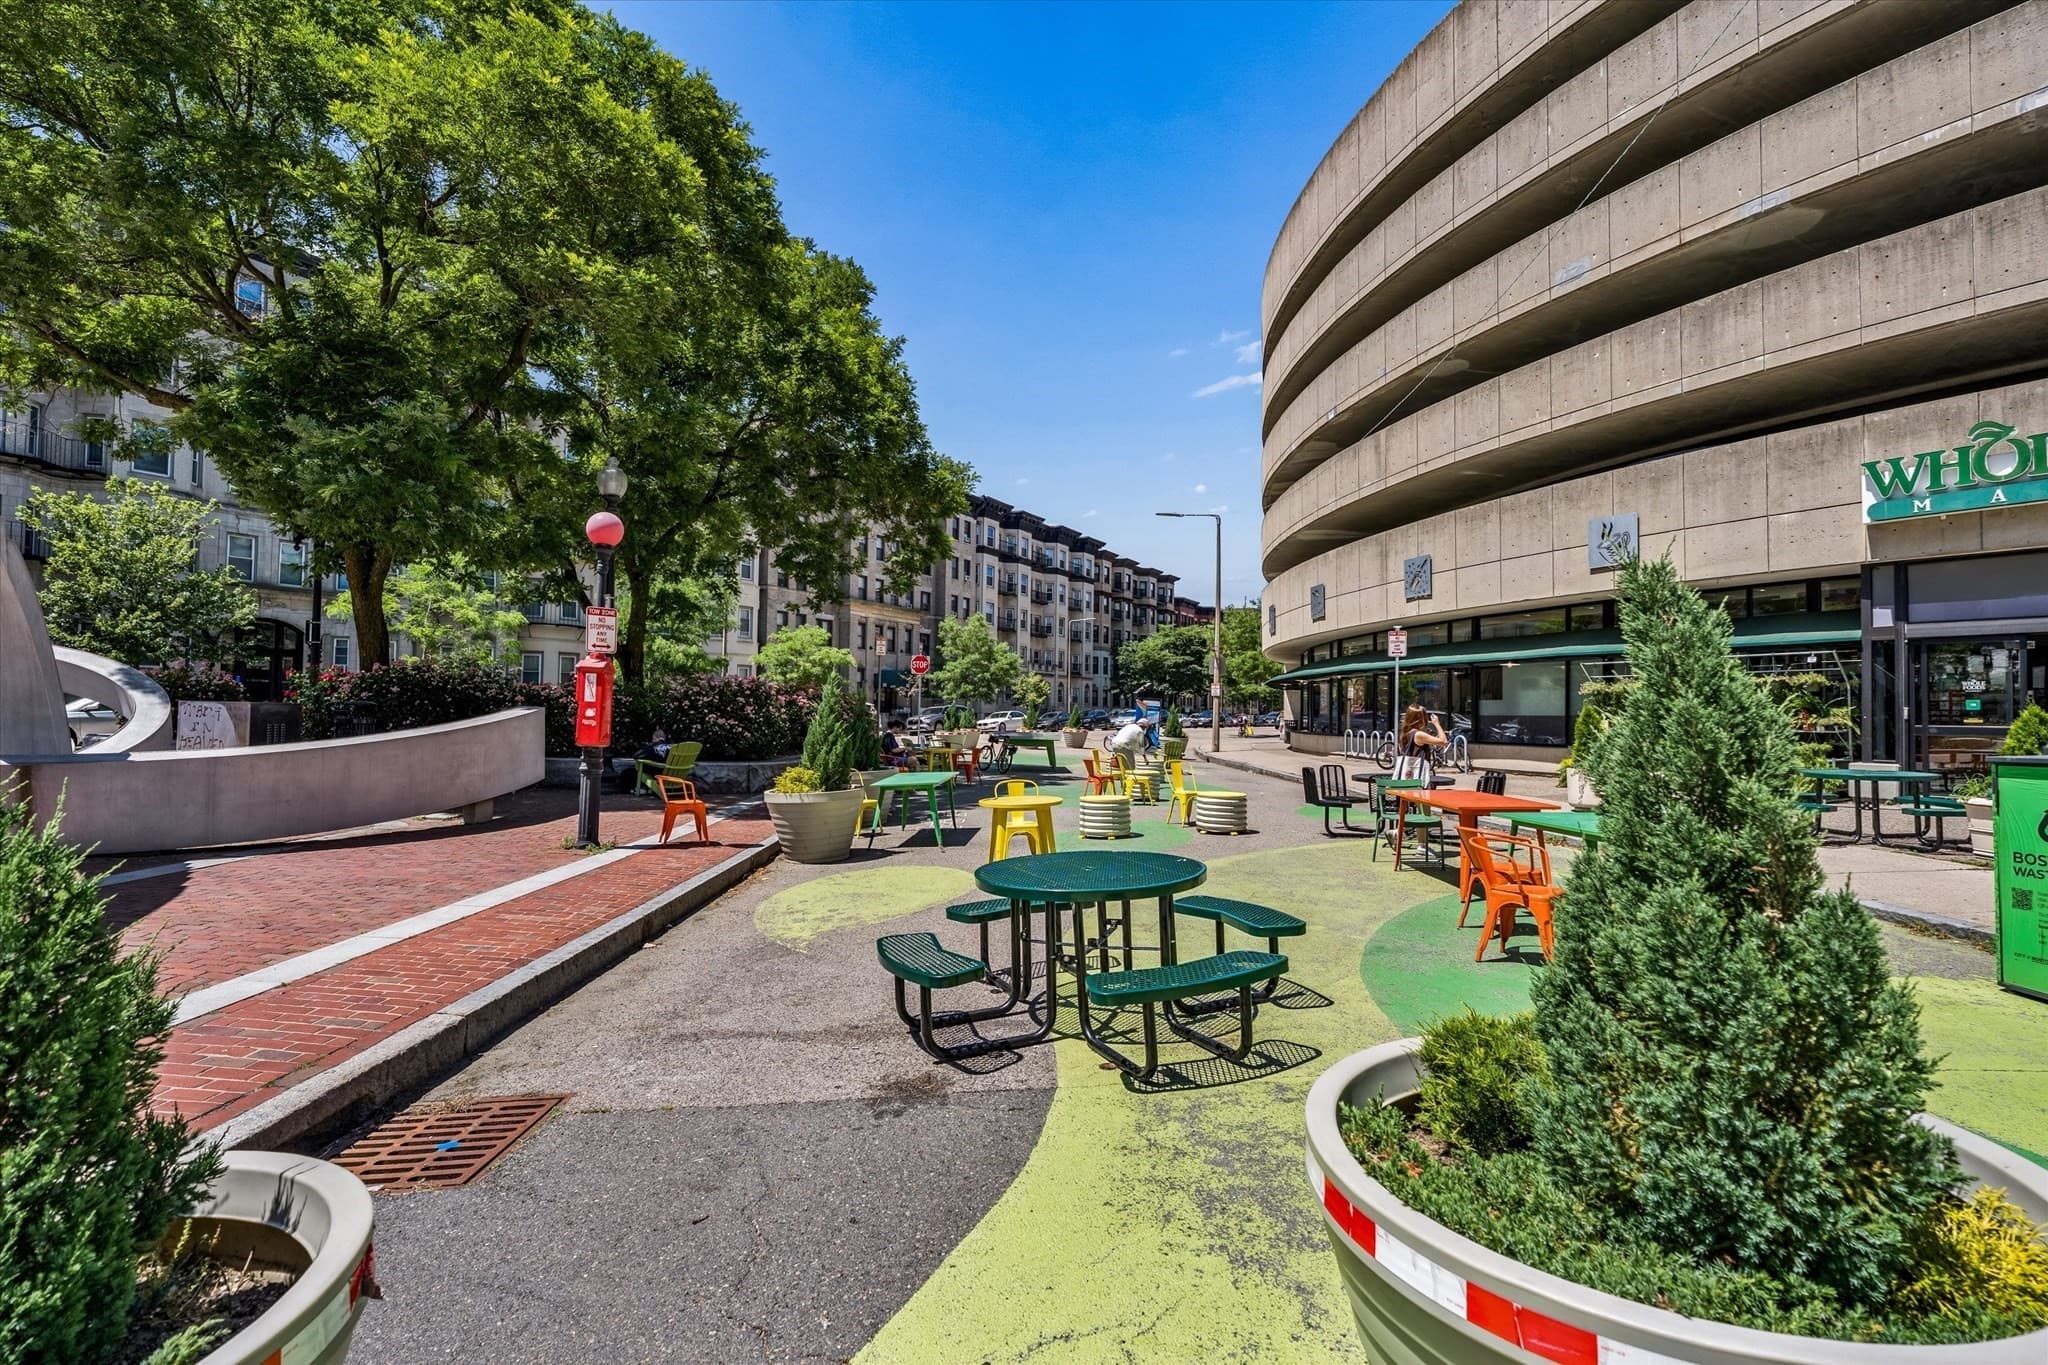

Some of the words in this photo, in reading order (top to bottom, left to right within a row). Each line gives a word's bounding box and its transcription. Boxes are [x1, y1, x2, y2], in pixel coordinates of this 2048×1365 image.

[588, 608, 601, 616] TOW
[601, 609, 616, 617] ZONE
[589, 623, 615, 631] STOPPING
[912, 661, 929, 669] STOP
